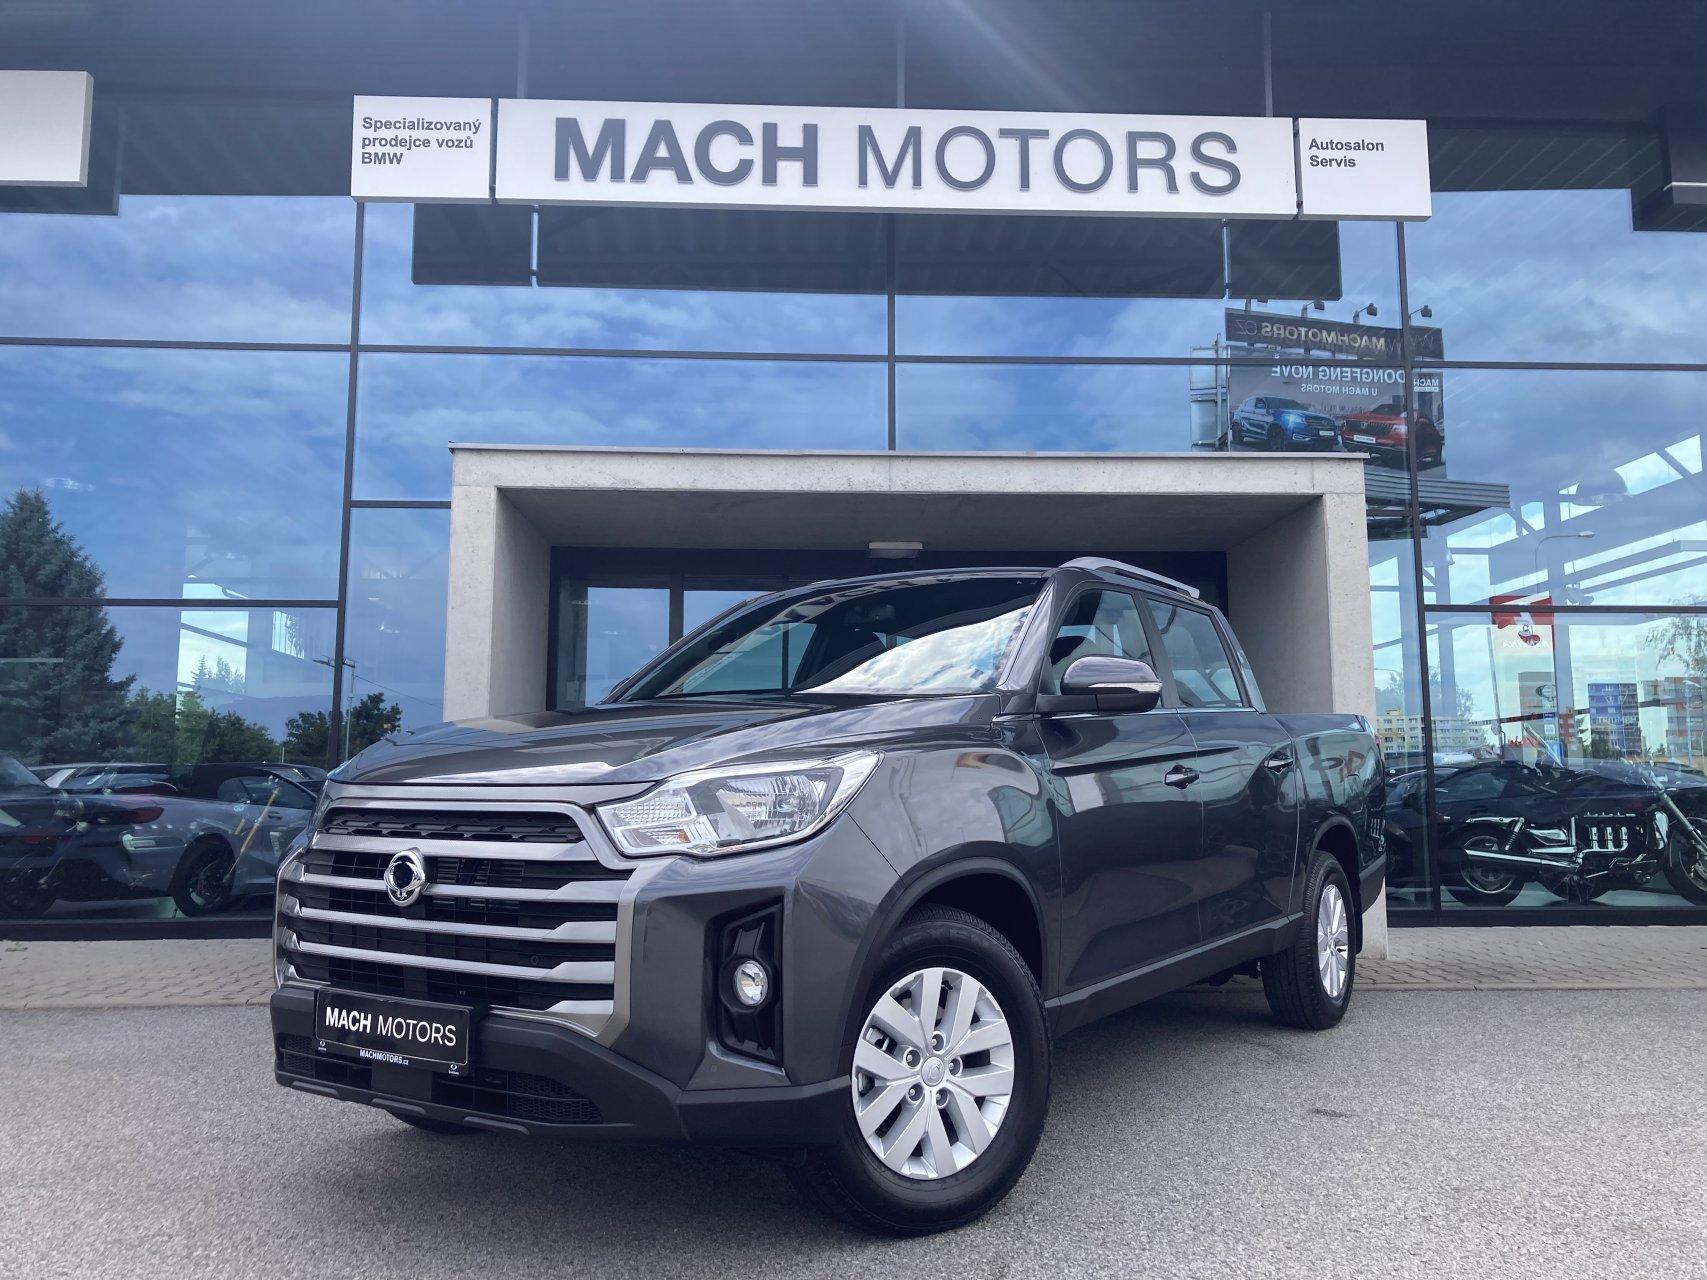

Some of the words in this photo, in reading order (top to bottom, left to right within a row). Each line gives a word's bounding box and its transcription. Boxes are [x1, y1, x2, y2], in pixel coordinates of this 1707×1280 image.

[362, 116, 482, 134] Specializovaný
[361, 135, 431, 151] prodejce
[436, 135, 474, 149] vozů
[1308, 138, 1385, 152] Autosalon
[361, 151, 403, 165] BMW
[554, 116, 819, 188] MACH
[858, 124, 1242, 197] MOTORS
[1309, 155, 1356, 168] Servis
[325, 1006, 371, 1034] MACH
[377, 1014, 457, 1047] MOTORS
[359, 1049, 409, 1066] MACHMOTORS.cz
